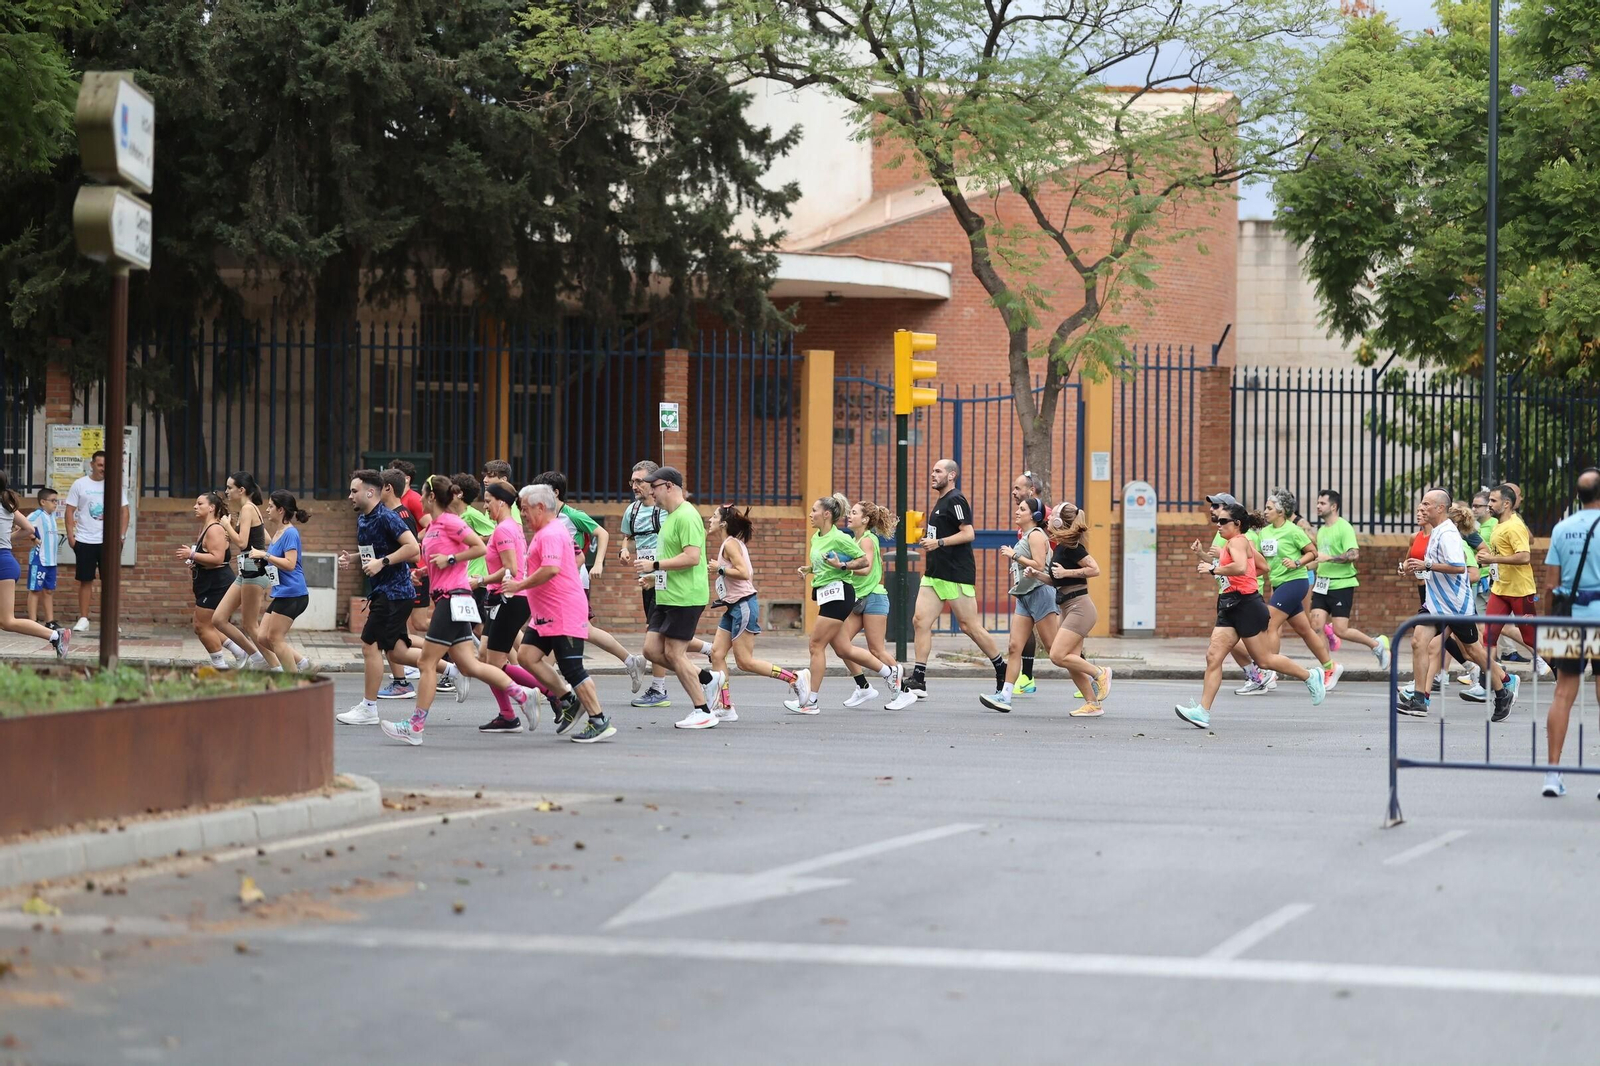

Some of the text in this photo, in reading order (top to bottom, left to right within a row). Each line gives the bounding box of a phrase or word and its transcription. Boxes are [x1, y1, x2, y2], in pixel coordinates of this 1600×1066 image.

[36, 572, 46, 580] 24
[820, 588, 840, 598] 1667
[458, 606, 476, 615] 761
